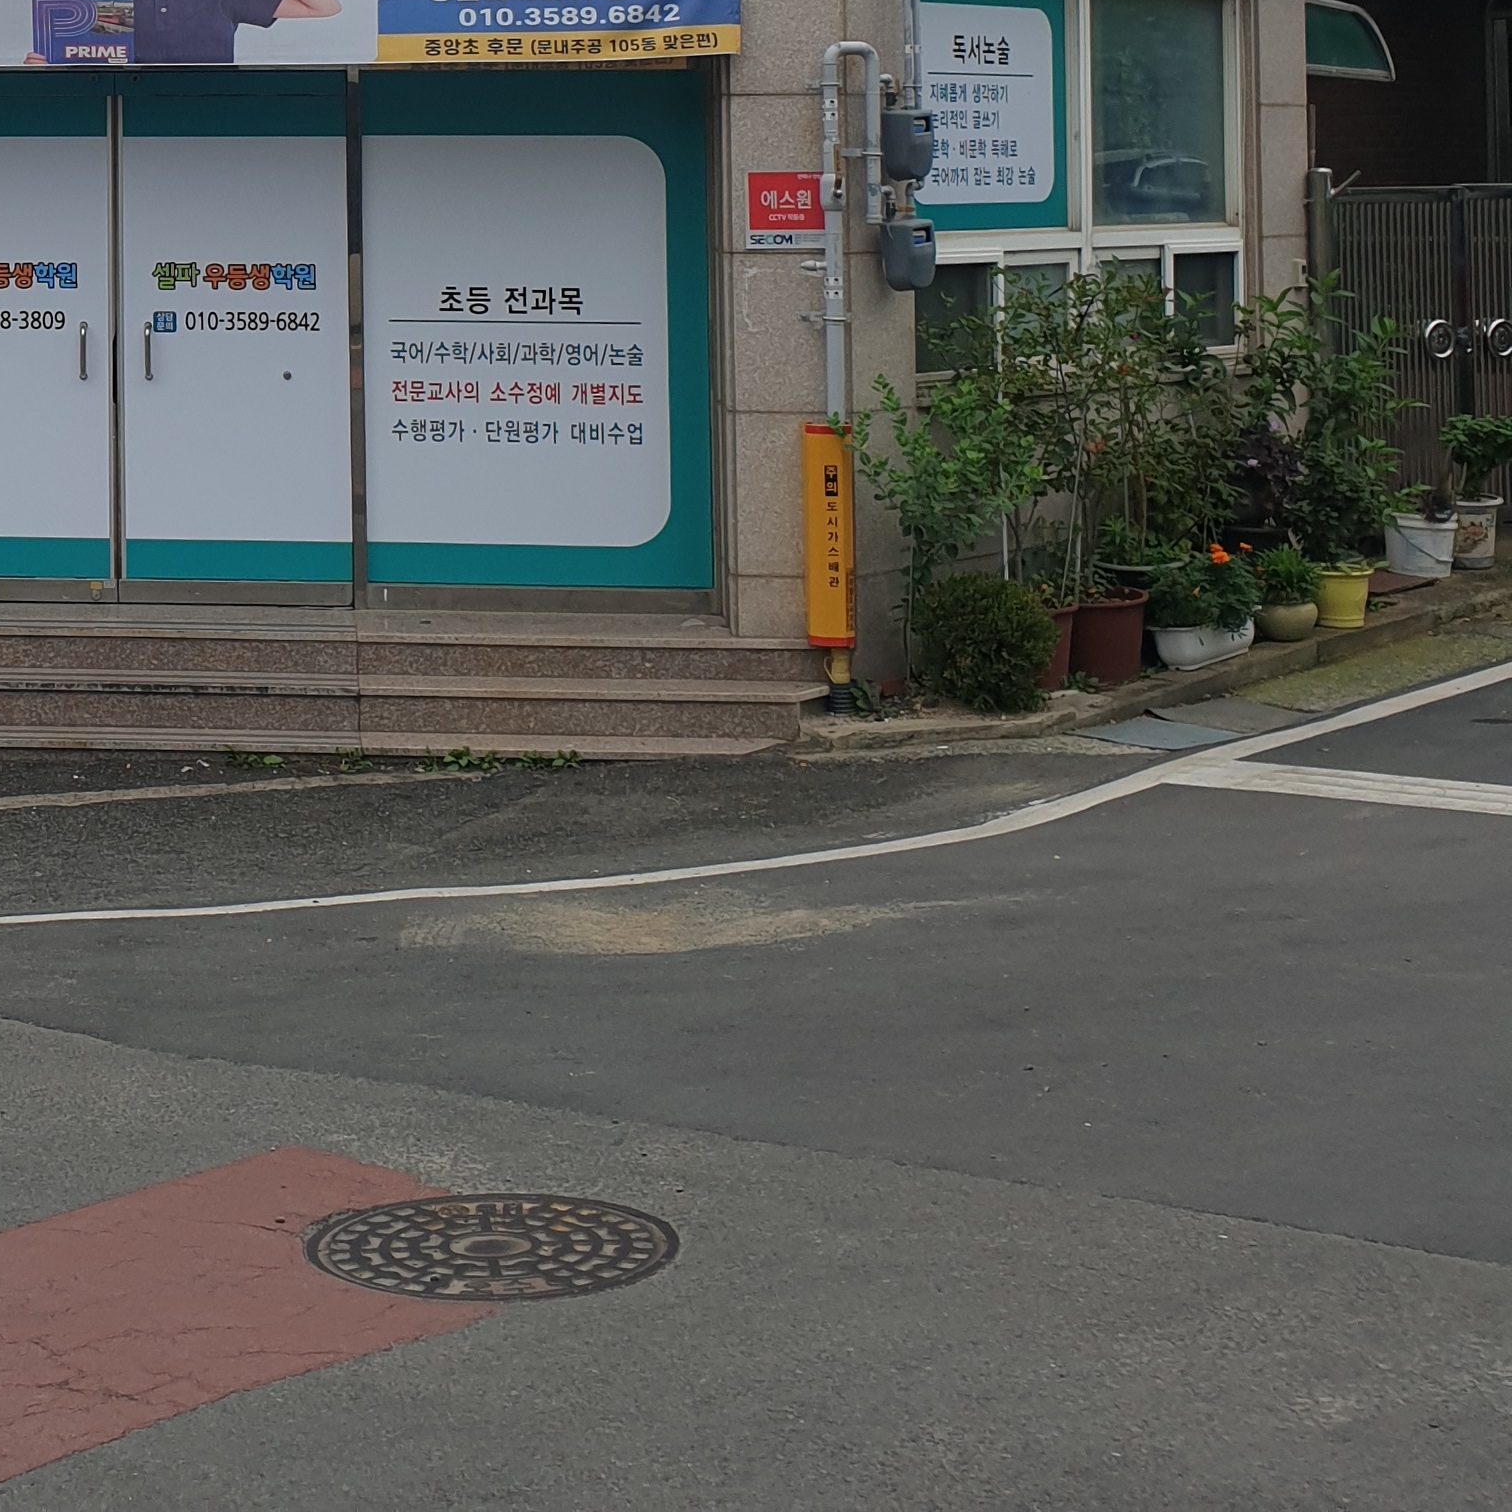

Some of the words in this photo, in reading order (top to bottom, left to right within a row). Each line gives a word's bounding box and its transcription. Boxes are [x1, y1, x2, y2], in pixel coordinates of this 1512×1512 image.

[459, 4, 680, 26] 010.3589.6842
[65, 46, 127, 58] PRIME
[425, 39, 480, 56] 중앙초
[487, 38, 523, 55] 후문
[531, 38, 602, 55] (문내주공
[610, 35, 656, 53] 105동
[662, 32, 718, 50] 맞은편)
[952, 35, 1011, 66] 독서논술
[930, 83, 967, 103] 지혜롭게
[972, 83, 1009, 103] 생각하기
[972, 110, 1000, 129] 글쓰기
[959, 139, 987, 159] 비문학
[991, 139, 1018, 159] 독해로
[931, 167, 968, 186] 국어까지
[973, 167, 992, 186] 잡는
[996, 166, 1014, 186] 최강
[1018, 166, 1036, 186] 논술
[760, 189, 812, 209] 에스원
[768, 213, 787, 221] CCTV
[750, 234, 793, 245] SECOM
[152, 262, 200, 290] 셀파
[203, 263, 316, 290] 우등생학원
[439, 286, 491, 315] 초등
[504, 286, 584, 315] 전과목
[185, 311, 320, 331] 010-3589-6842
[390, 341, 644, 367] 국어/수학/사회/과학/영어/논술
[391, 380, 480, 404] 전문교사의
[490, 381, 561, 405] 소수정예
[572, 382, 644, 406] 개별지도
[391, 418, 464, 443] 수행평가
[486, 420, 559, 445] 단원평가
[571, 421, 644, 445] 대비수업
[825, 466, 838, 494] 주의
